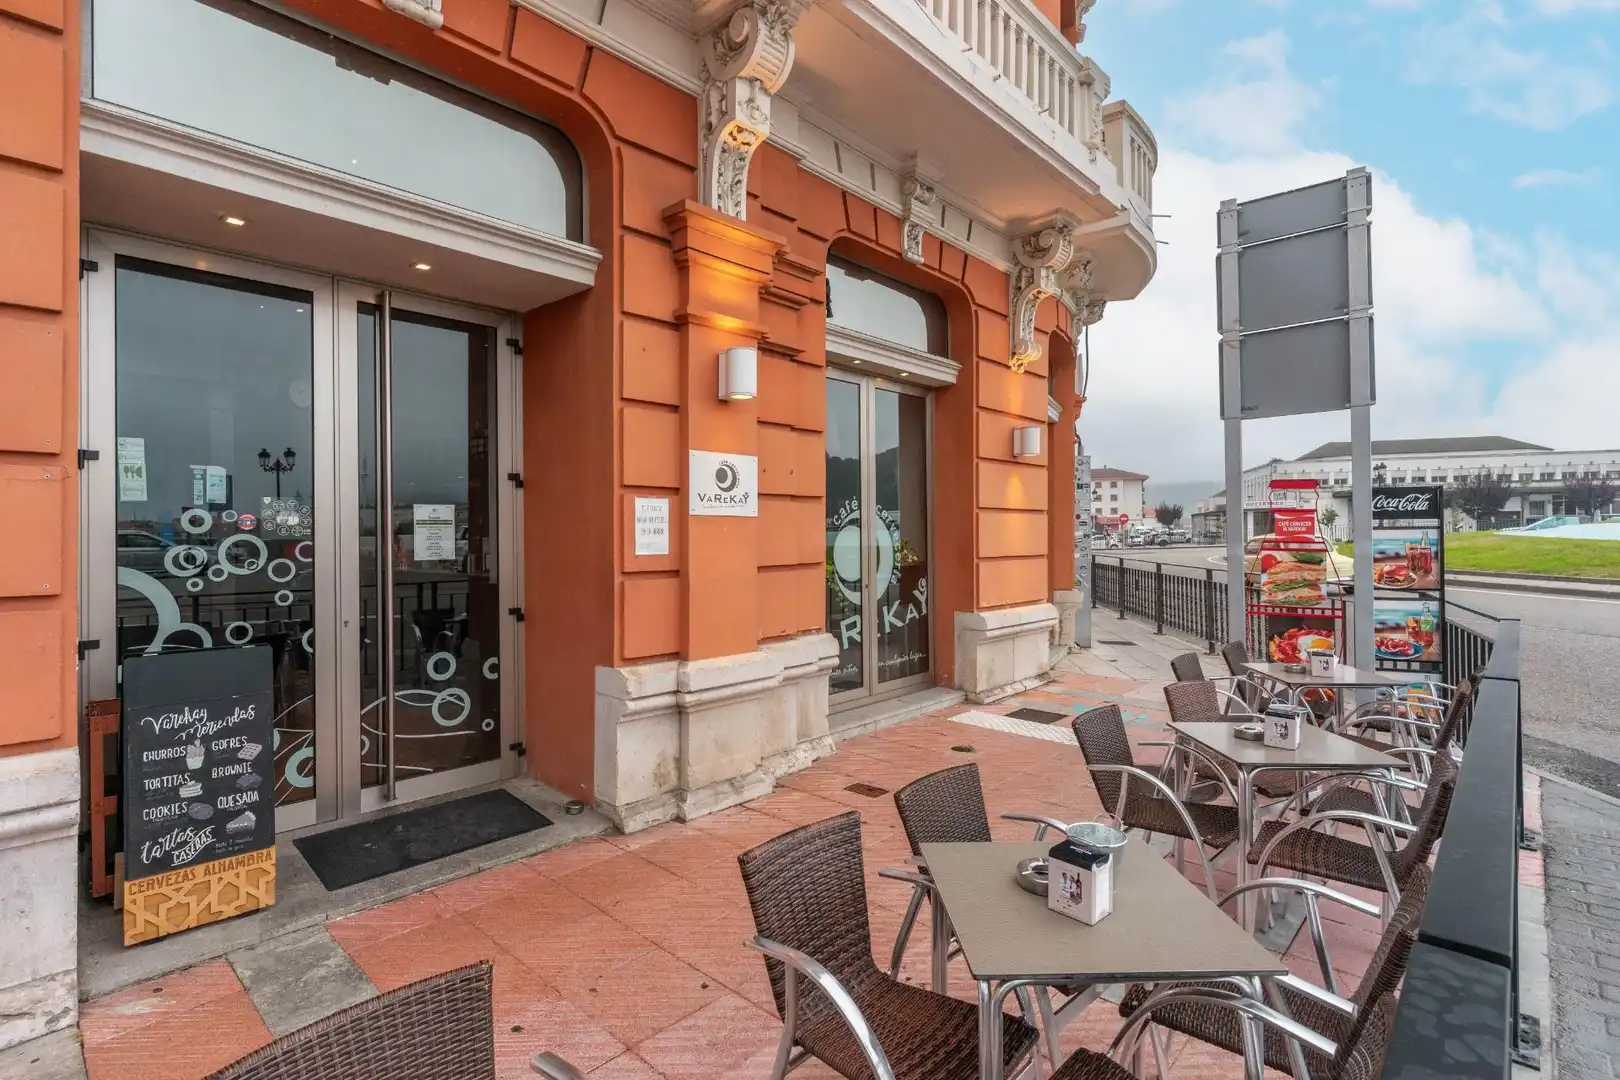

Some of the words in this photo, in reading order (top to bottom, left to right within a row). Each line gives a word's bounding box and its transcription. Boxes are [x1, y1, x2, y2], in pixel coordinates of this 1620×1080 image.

[833, 496, 859, 526] café
[1372, 493, 1432, 511] Coca-Cola
[211, 735, 248, 751] GOFRES
[143, 745, 186, 762] CHURROS
[211, 762, 253, 779] BROWNIE
[143, 772, 191, 791] TORTITAS
[217, 790, 260, 809] QUESADA
[143, 801, 188, 821] COOKIES
[173, 828, 212, 864] CASERAS
[128, 867, 196, 896] CERVEZAS
[203, 850, 273, 878] ALHAMBRA
